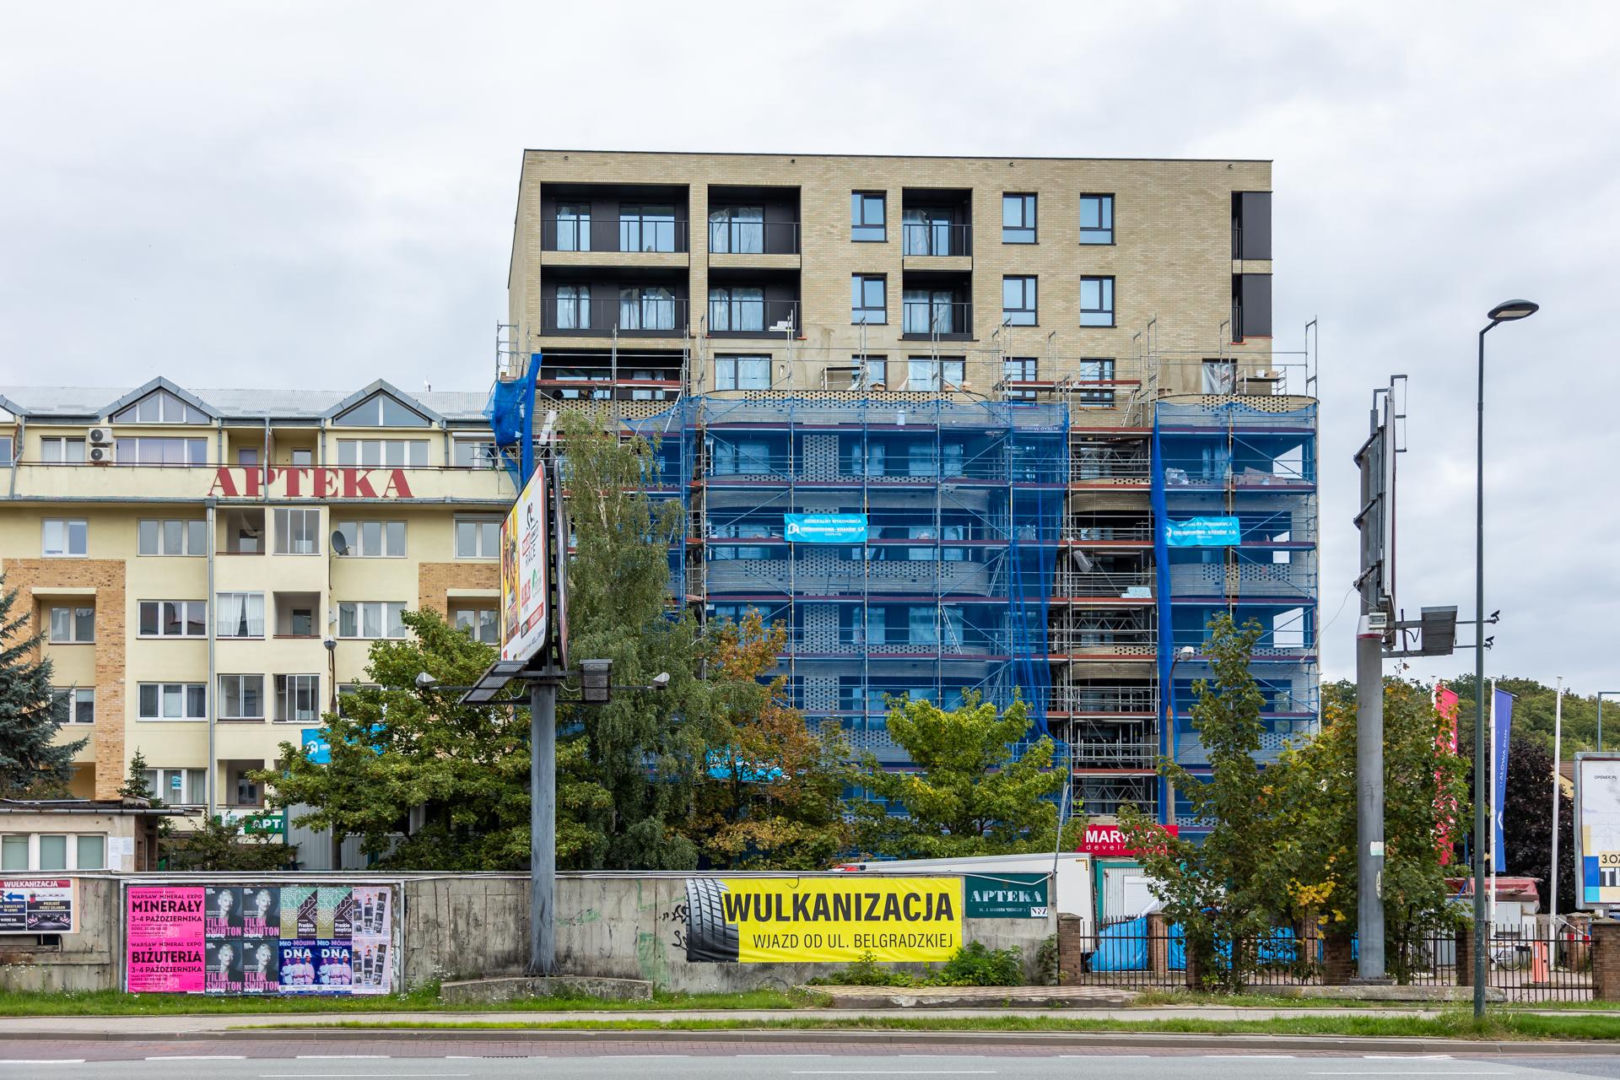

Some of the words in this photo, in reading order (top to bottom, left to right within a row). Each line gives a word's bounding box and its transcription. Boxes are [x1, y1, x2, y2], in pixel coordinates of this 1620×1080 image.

[208, 467, 415, 497] APTEKA
[970, 890, 1042, 902] APTEKA
[132, 901, 202, 912] MINERAŁY
[724, 892, 954, 922] WULKANIZACJA
[753, 934, 799, 949] WJAZD
[804, 934, 823, 949] OD
[828, 934, 849, 949] UL.
[854, 934, 953, 948] BELGRADZKIEJ
[132, 948, 202, 963] BIŻUTERIA
[284, 949, 312, 958] DNA
[322, 949, 350, 958] DNA
